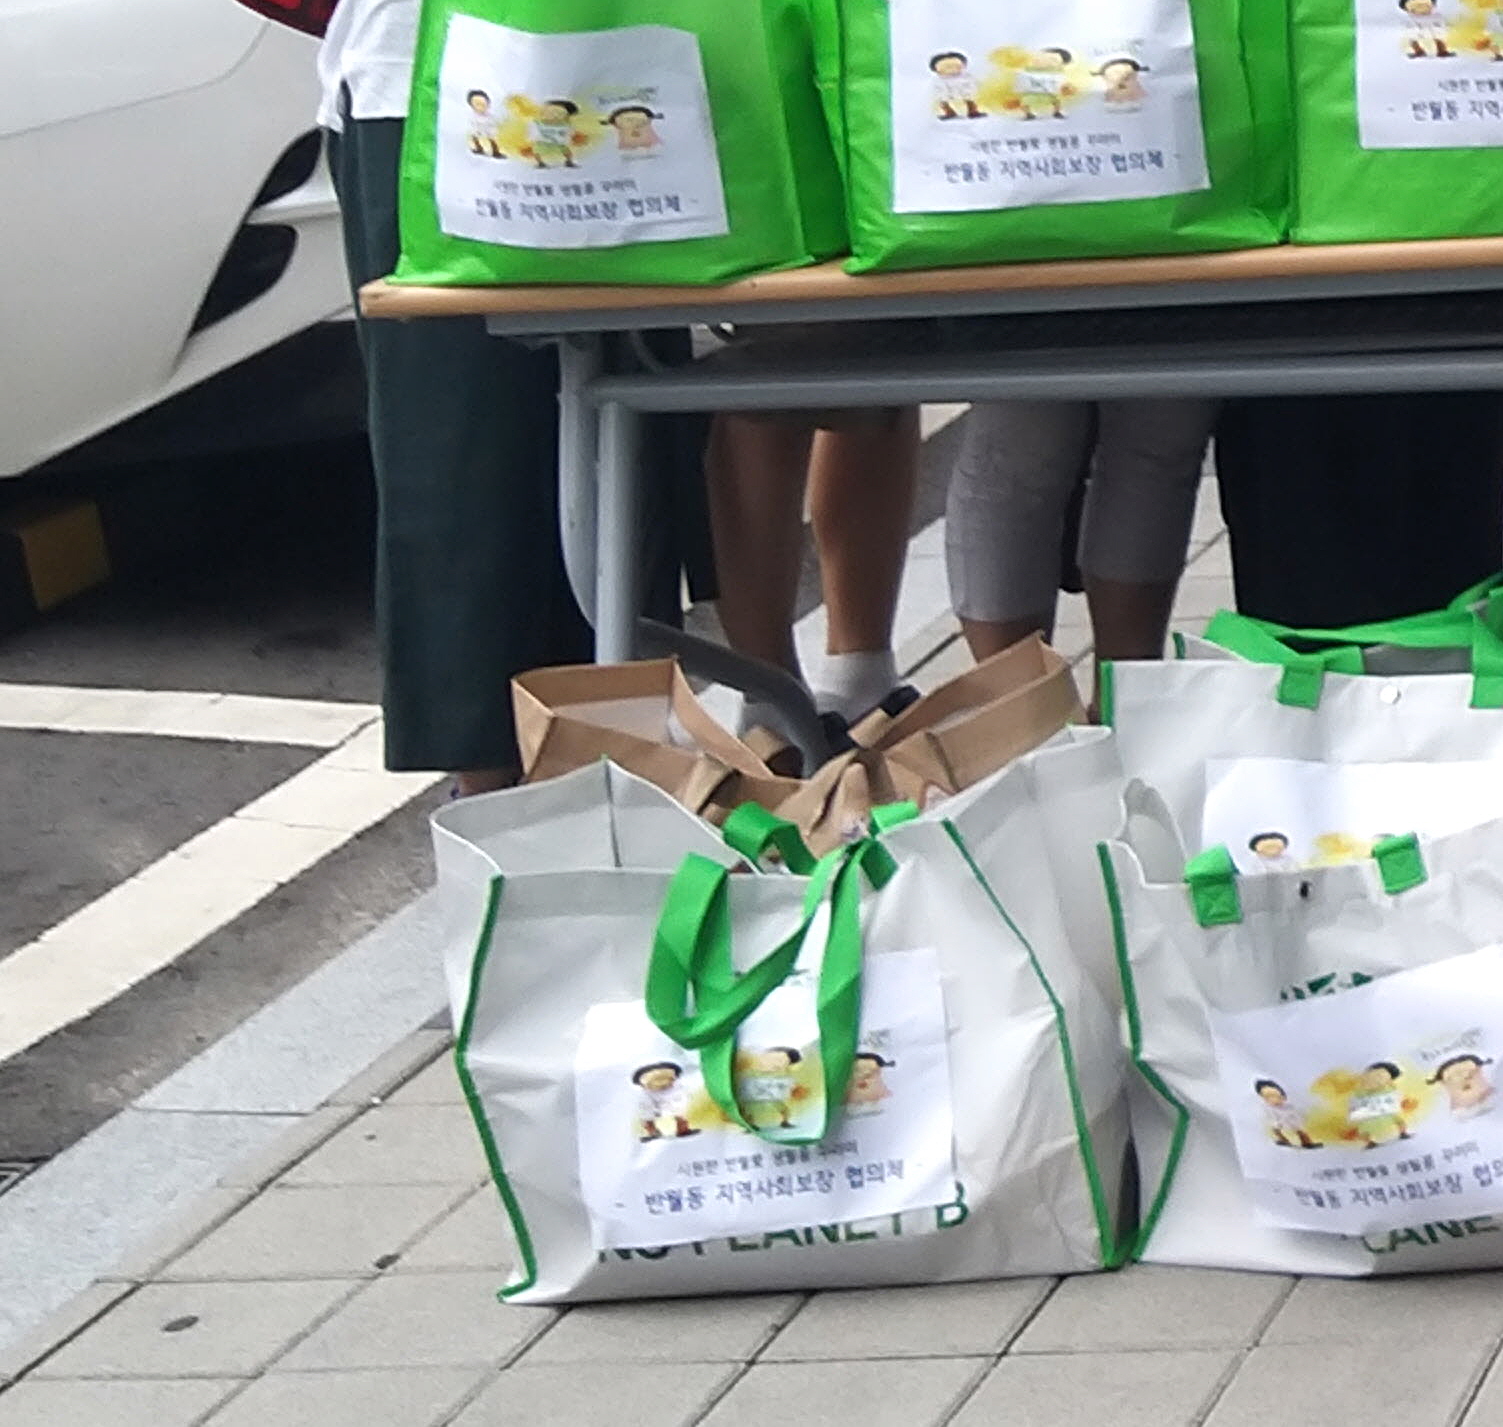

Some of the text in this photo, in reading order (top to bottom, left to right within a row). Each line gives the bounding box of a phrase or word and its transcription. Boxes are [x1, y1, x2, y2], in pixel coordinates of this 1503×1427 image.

[1411, 99, 1459, 123] 반월동
[1110, 149, 1164, 172] 협의체
[627, 194, 683, 217] 협의체
[644, 1185, 706, 1215] 반월동
[715, 1167, 834, 1206] 지역사회보장
